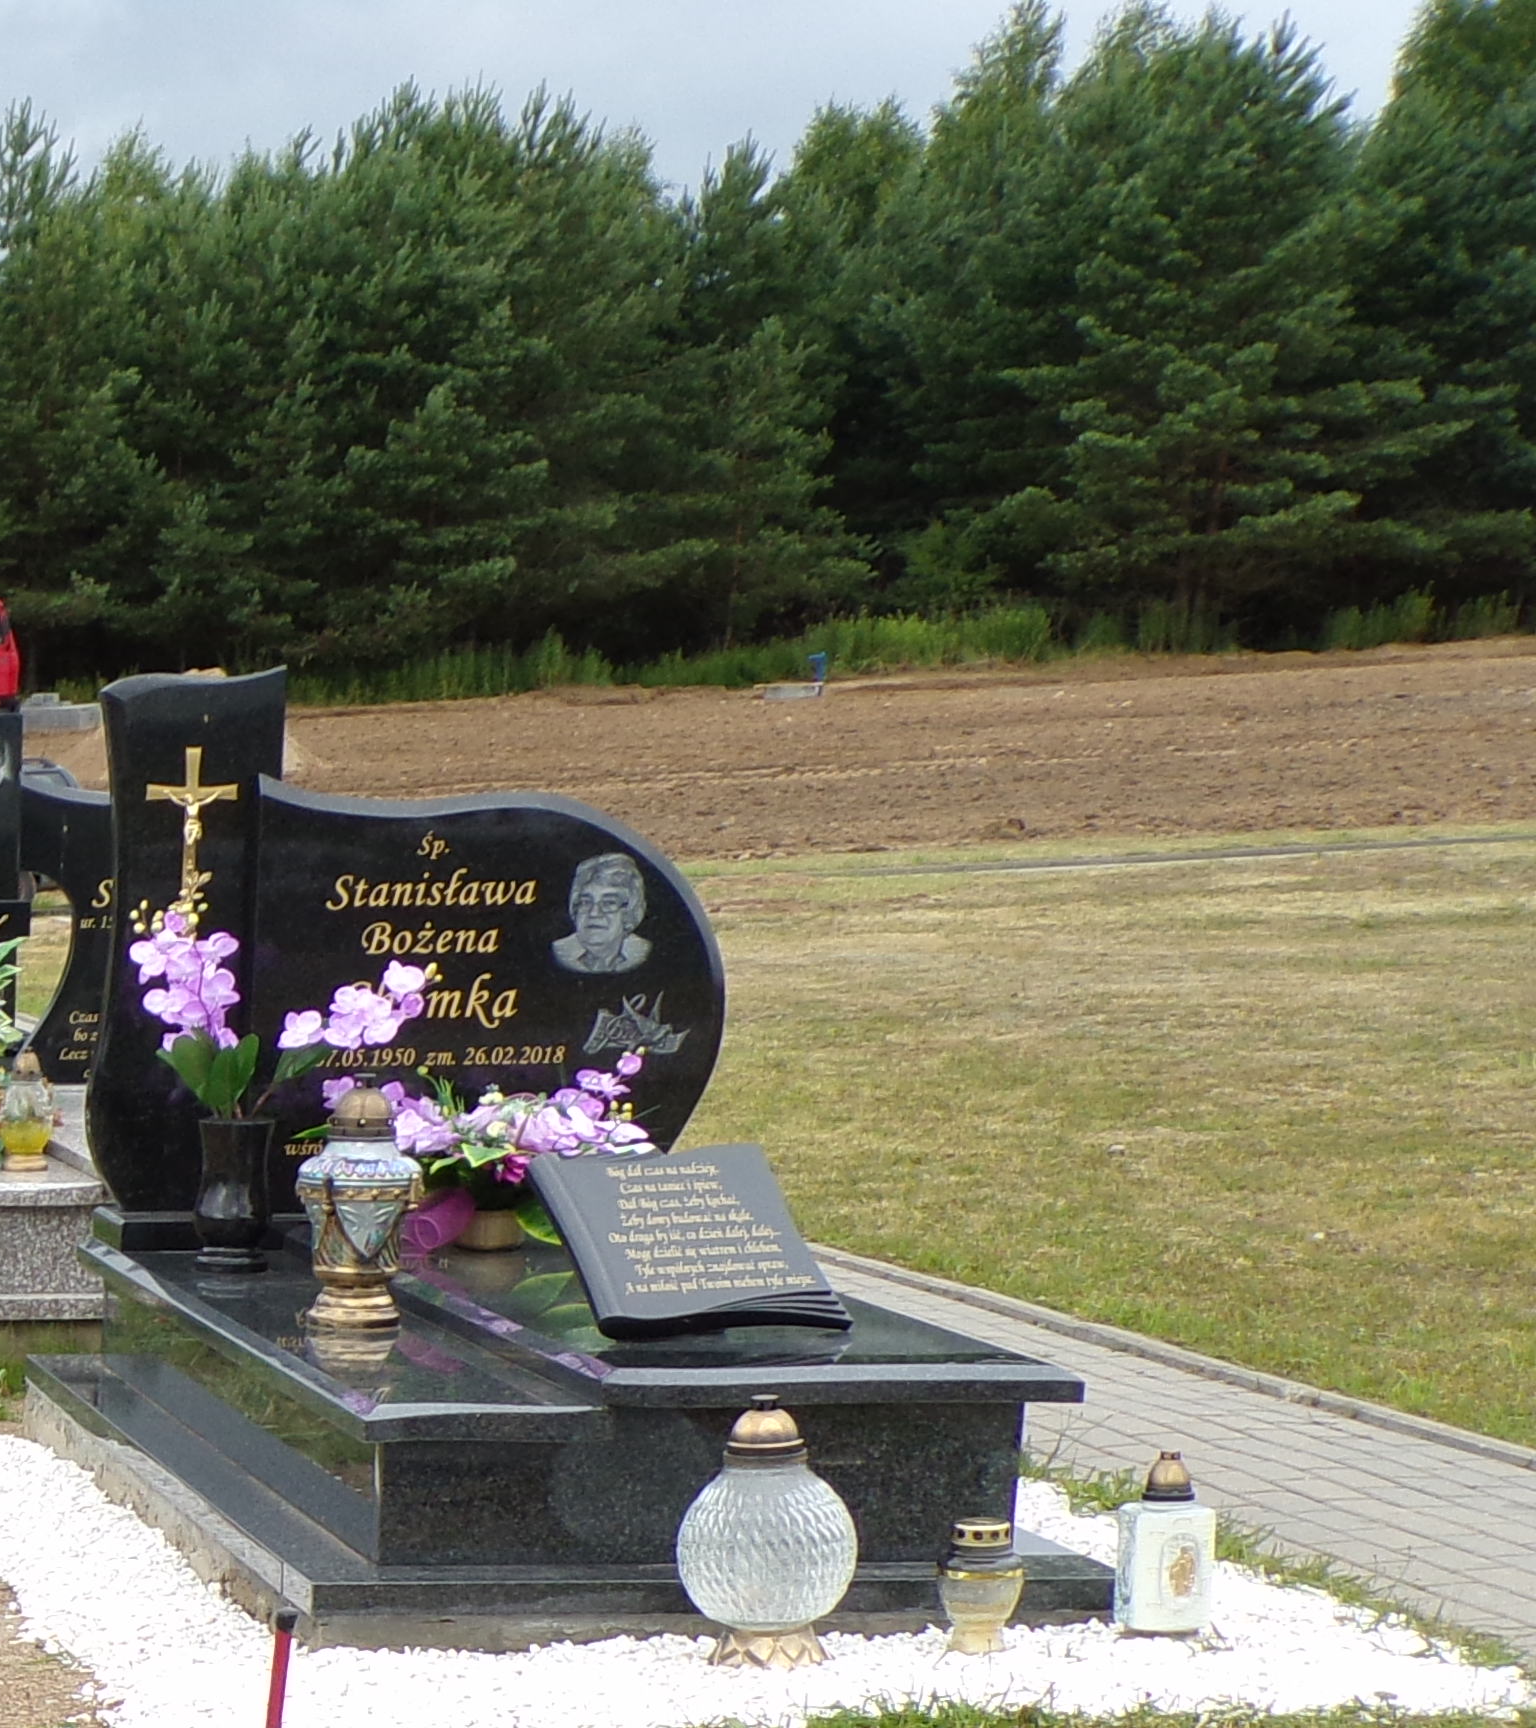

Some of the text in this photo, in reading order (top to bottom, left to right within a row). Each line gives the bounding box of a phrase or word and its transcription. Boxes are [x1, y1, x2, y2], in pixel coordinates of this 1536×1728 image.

[417, 830, 451, 859] Śp.
[325, 868, 537, 911] Stanisława
[361, 920, 500, 955] Bożena
[427, 1053, 457, 1066] zm.
[463, 1045, 567, 1066] 26.02.2018
